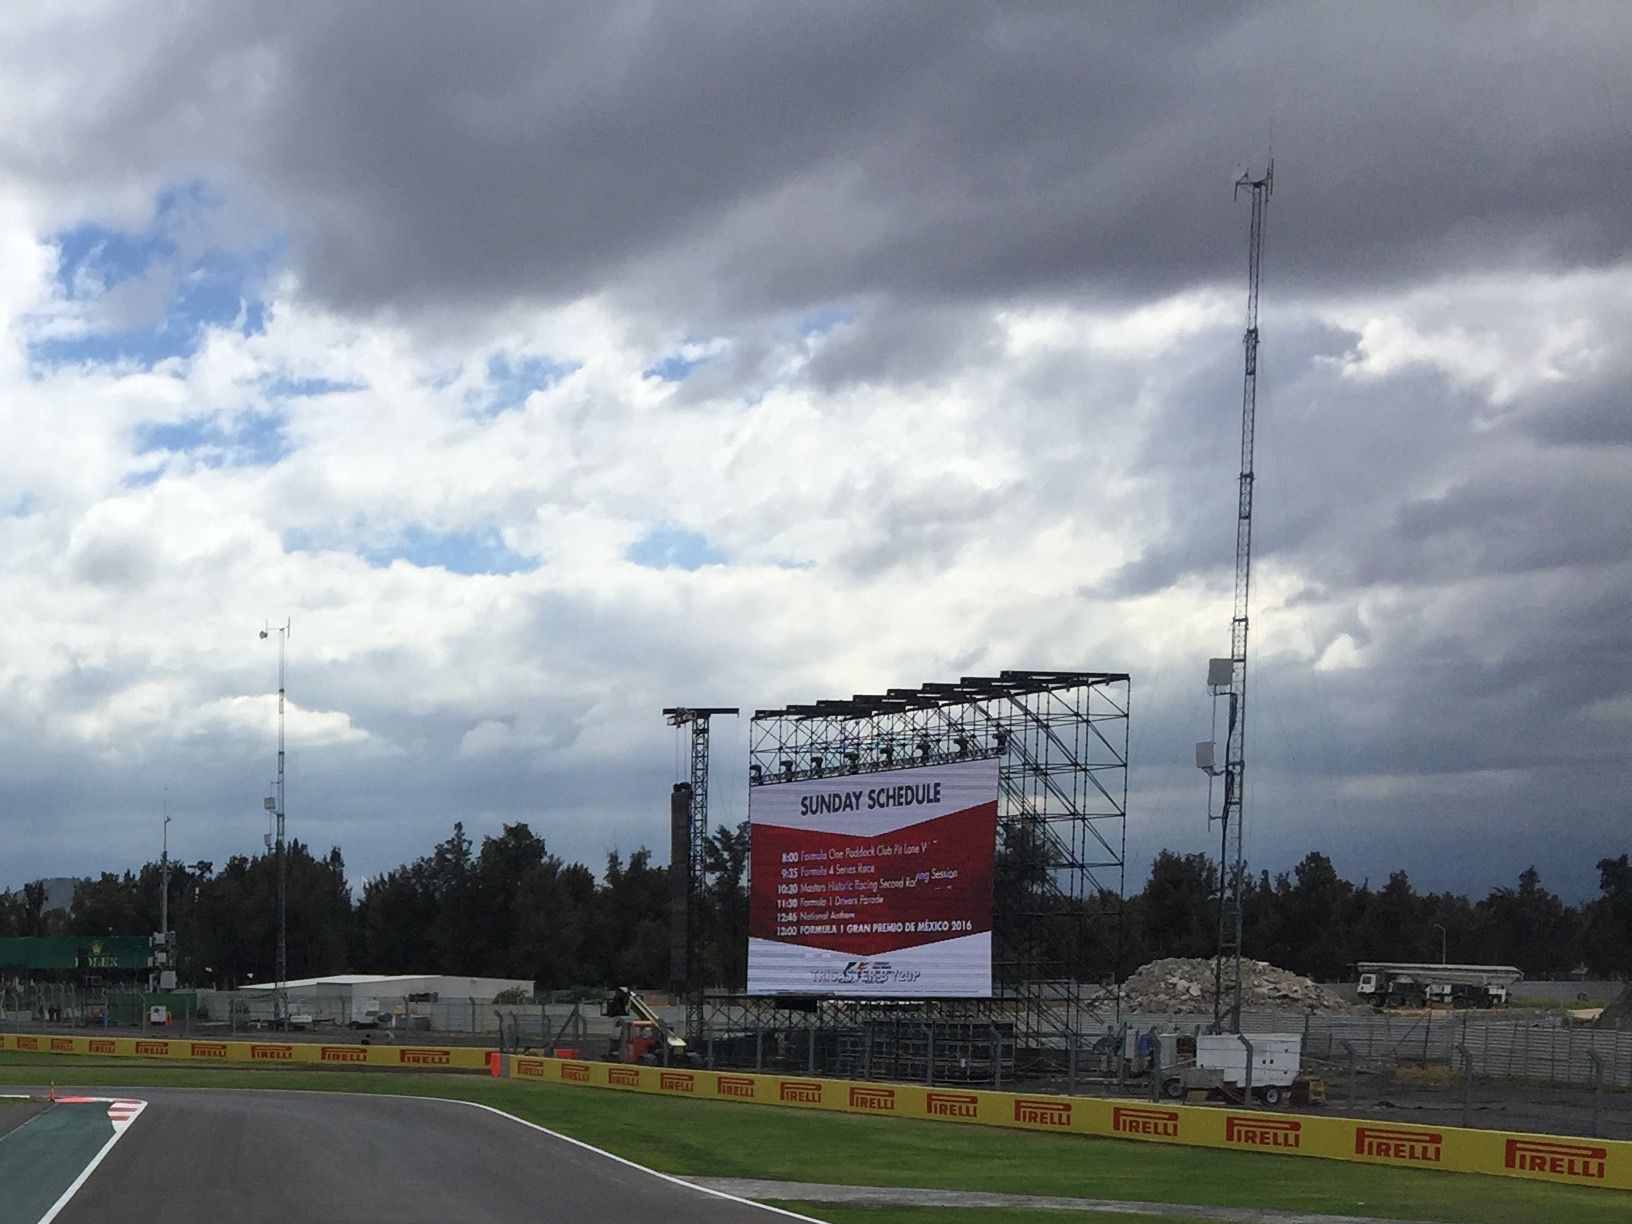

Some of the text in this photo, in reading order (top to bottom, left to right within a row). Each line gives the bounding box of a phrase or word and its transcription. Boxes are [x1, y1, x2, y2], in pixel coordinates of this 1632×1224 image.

[800, 782, 941, 816] SUNDAY SCHEDULE
[845, 845, 875, 858] Paddock
[876, 844, 893, 856] Club
[904, 843, 919, 855] Lane
[835, 864, 856, 875] Series
[858, 863, 875, 873] Race
[879, 876, 904, 889] Second
[931, 868, 958, 880] Session
[800, 925, 837, 935] FORMULA
[846, 923, 871, 933] GRAN
[872, 922, 903, 933] PREMIO
[905, 921, 916, 932] DE
[917, 918, 949, 932] MÉXICO
[951, 920, 972, 931] 2016
[191, 1043, 227, 1057] PIRELLI
[251, 1044, 292, 1059] PIRELLI
[321, 1045, 367, 1062] PIRELLI
[399, 1048, 450, 1064] PIRELLI
[561, 1063, 589, 1082] PIRELLI
[608, 1067, 639, 1087] PIRELLI
[660, 1072, 694, 1092] PIRELLI
[718, 1076, 755, 1098] PIRELLI
[779, 1081, 822, 1103] PIRELLI
[849, 1087, 895, 1110] PIRELLI
[927, 1093, 978, 1118] PIRELLI
[1014, 1099, 1072, 1126] PIRELLI
[1113, 1106, 1179, 1137] PIRELLI
[1226, 1116, 1301, 1148] PIRELLI
[1355, 1127, 1443, 1162] PIRELLI
[1505, 1138, 1607, 1179] PIRELLI
